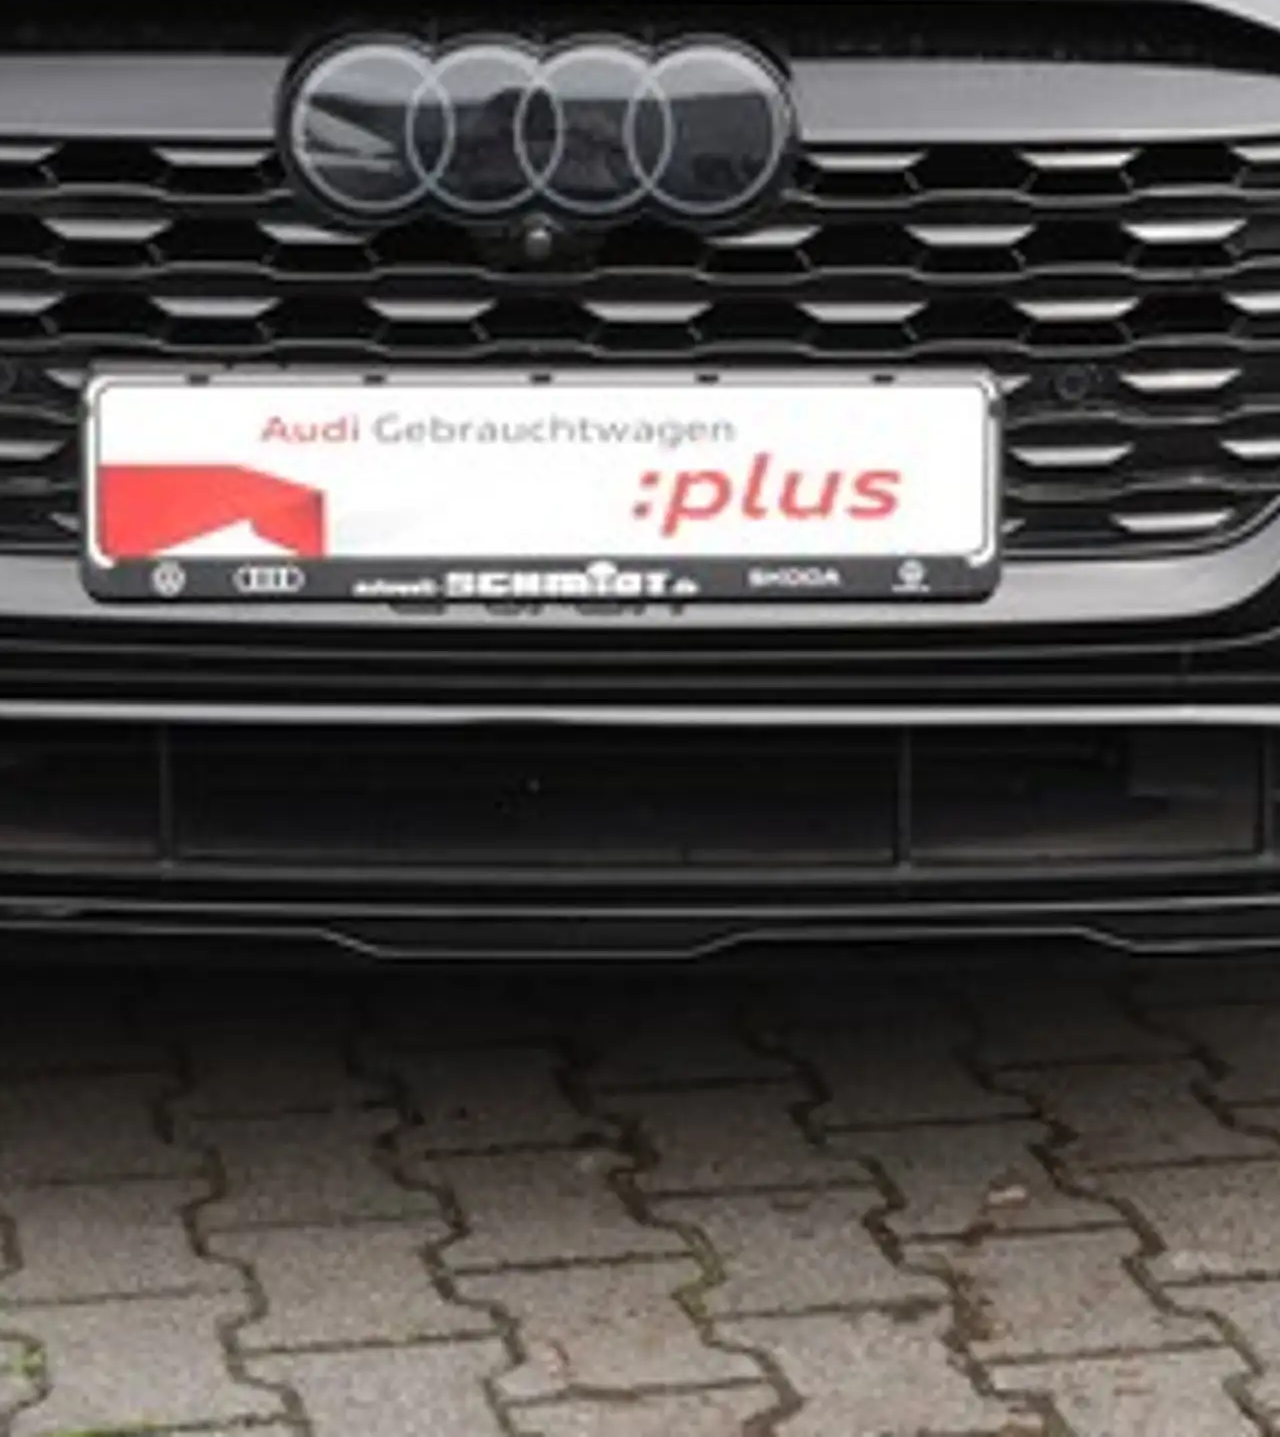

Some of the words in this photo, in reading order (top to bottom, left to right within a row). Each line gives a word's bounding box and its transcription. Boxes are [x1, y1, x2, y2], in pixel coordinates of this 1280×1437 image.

[260, 414, 359, 443] Audi
[371, 414, 736, 447] Gebrauchtwagen
[631, 452, 903, 537] :plus
